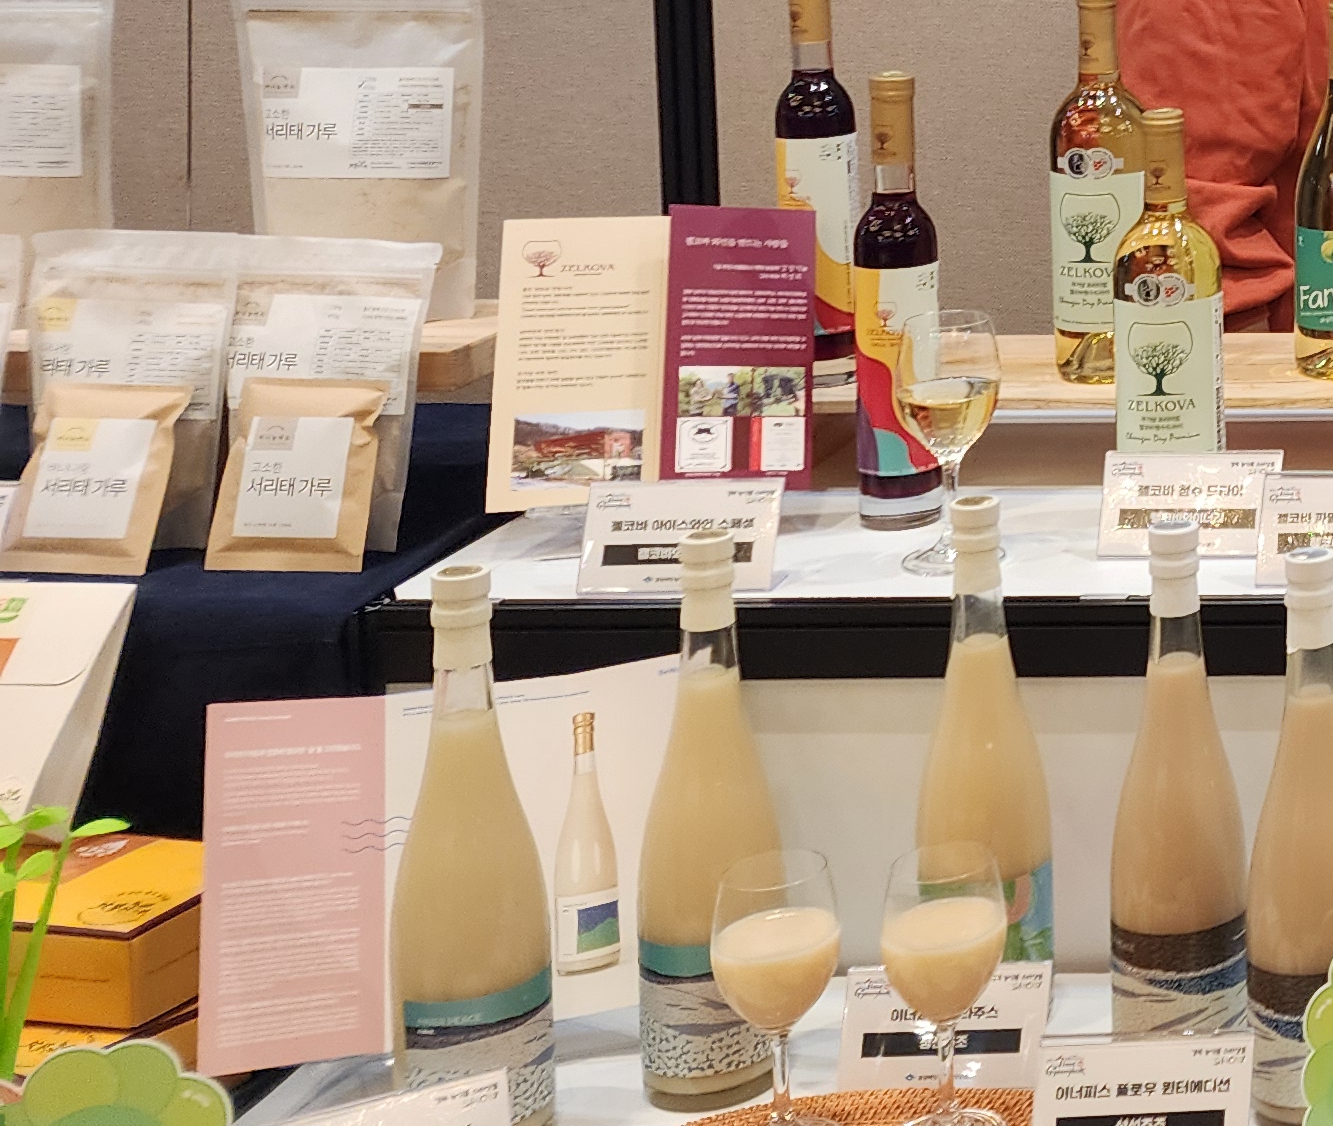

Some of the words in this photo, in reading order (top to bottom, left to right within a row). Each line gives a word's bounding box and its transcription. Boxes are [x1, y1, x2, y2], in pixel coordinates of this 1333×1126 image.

[306, 122, 338, 141] 가루
[1059, 265, 1114, 279] ZELKOV
[42, 357, 72, 377] 리태
[266, 352, 299, 371] 가루
[1127, 398, 1196, 413] ZELKOVA
[40, 478, 91, 498] 서리태
[91, 477, 128, 498] 가루
[246, 476, 295, 497] 서리태
[297, 477, 333, 498] 가루
[1055, 1083, 1111, 1101] 이너피스
[1161, 1077, 1231, 1096] 윈터에디션
